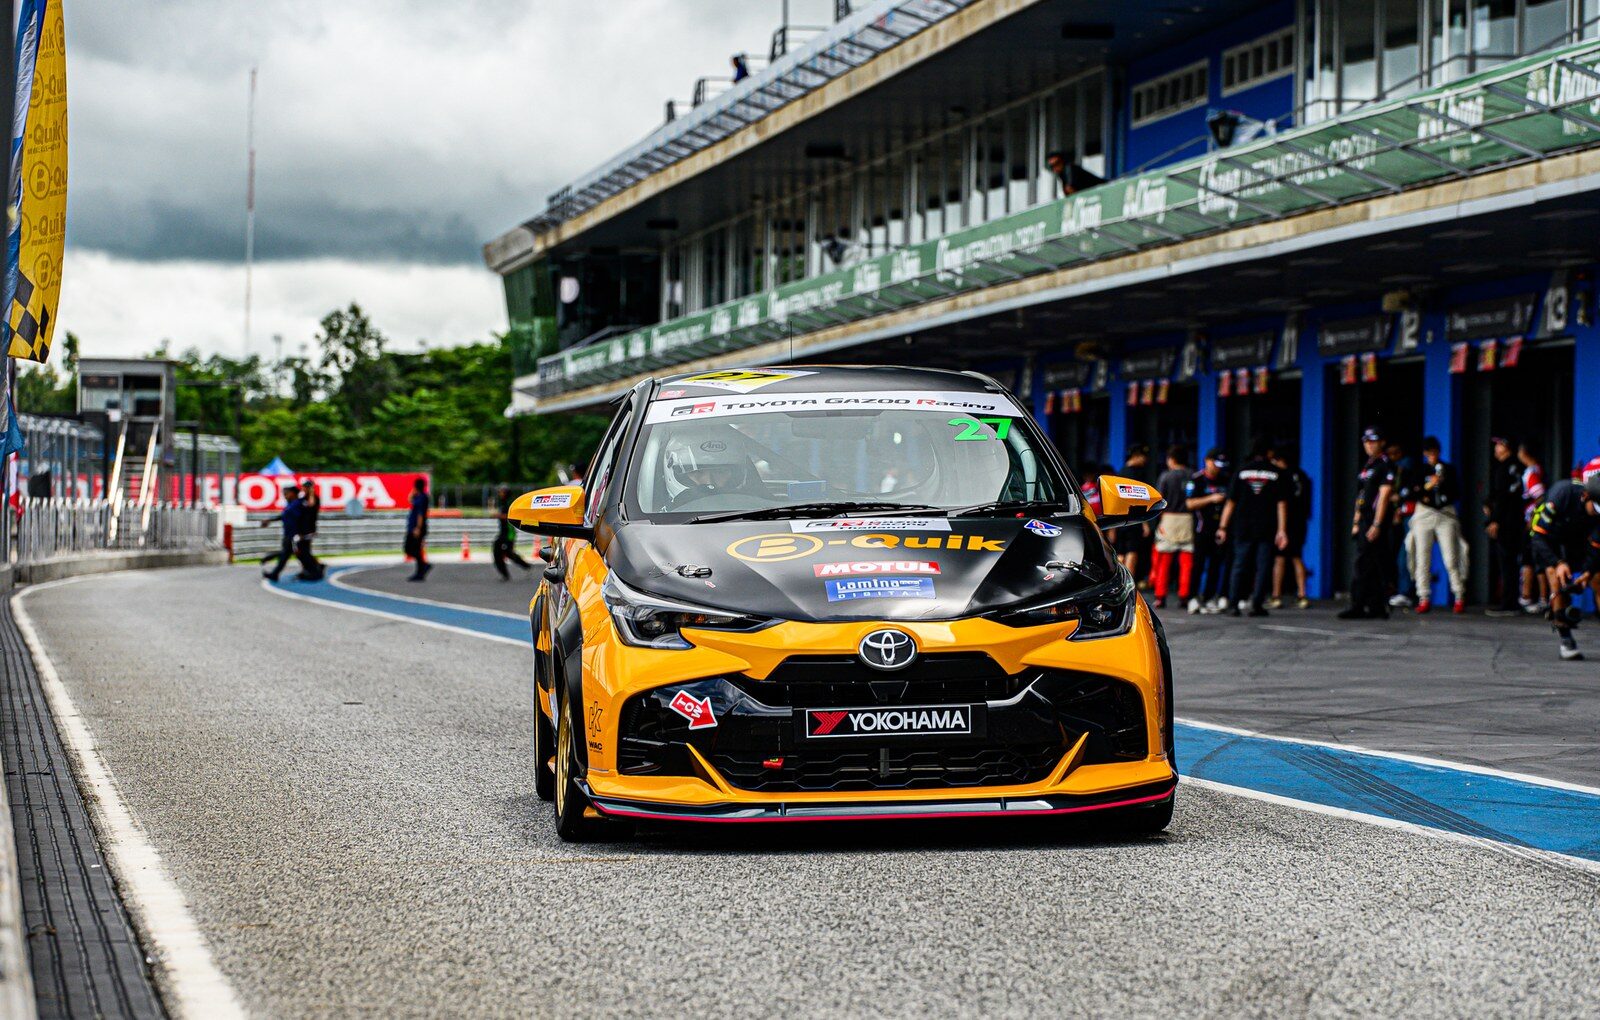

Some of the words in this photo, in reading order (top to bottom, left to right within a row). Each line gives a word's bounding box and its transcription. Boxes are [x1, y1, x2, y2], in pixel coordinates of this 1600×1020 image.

[671, 402, 716, 417] GR
[722, 399, 818, 410] TOYOTA
[916, 399, 996, 411] Racing
[948, 418, 1012, 442] 27
[727, 533, 1006, 561] B-Quik
[820, 561, 937, 575] MOTUL
[837, 590, 921, 599] DIGITAL
[676, 697, 703, 719] TOW
[848, 710, 967, 732] YOKOHAMA
[588, 740, 603, 750] WAC
